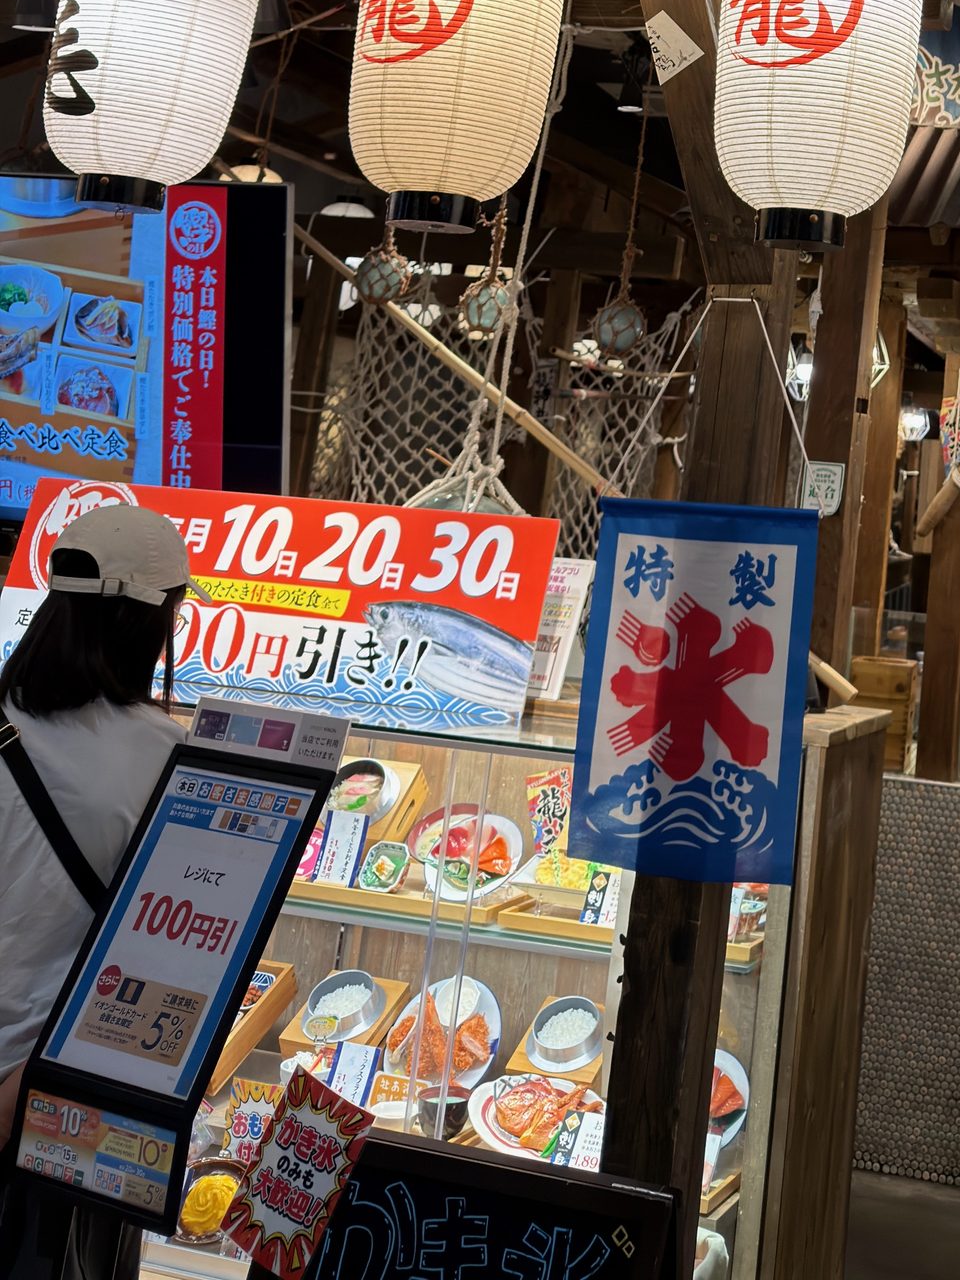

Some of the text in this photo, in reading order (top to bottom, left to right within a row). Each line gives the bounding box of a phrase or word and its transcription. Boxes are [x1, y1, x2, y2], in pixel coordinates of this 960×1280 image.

[607, 591, 775, 782] 氷
[183, 865, 226, 887] レジにて
[132, 892, 239, 955] 100円引
[351, 1050, 369, 1103] ミックスフライ
[276, 1115, 341, 1172] かき氷
[252, 1168, 325, 1226] 大歓迎!
[277, 1155, 314, 1190] のみも
